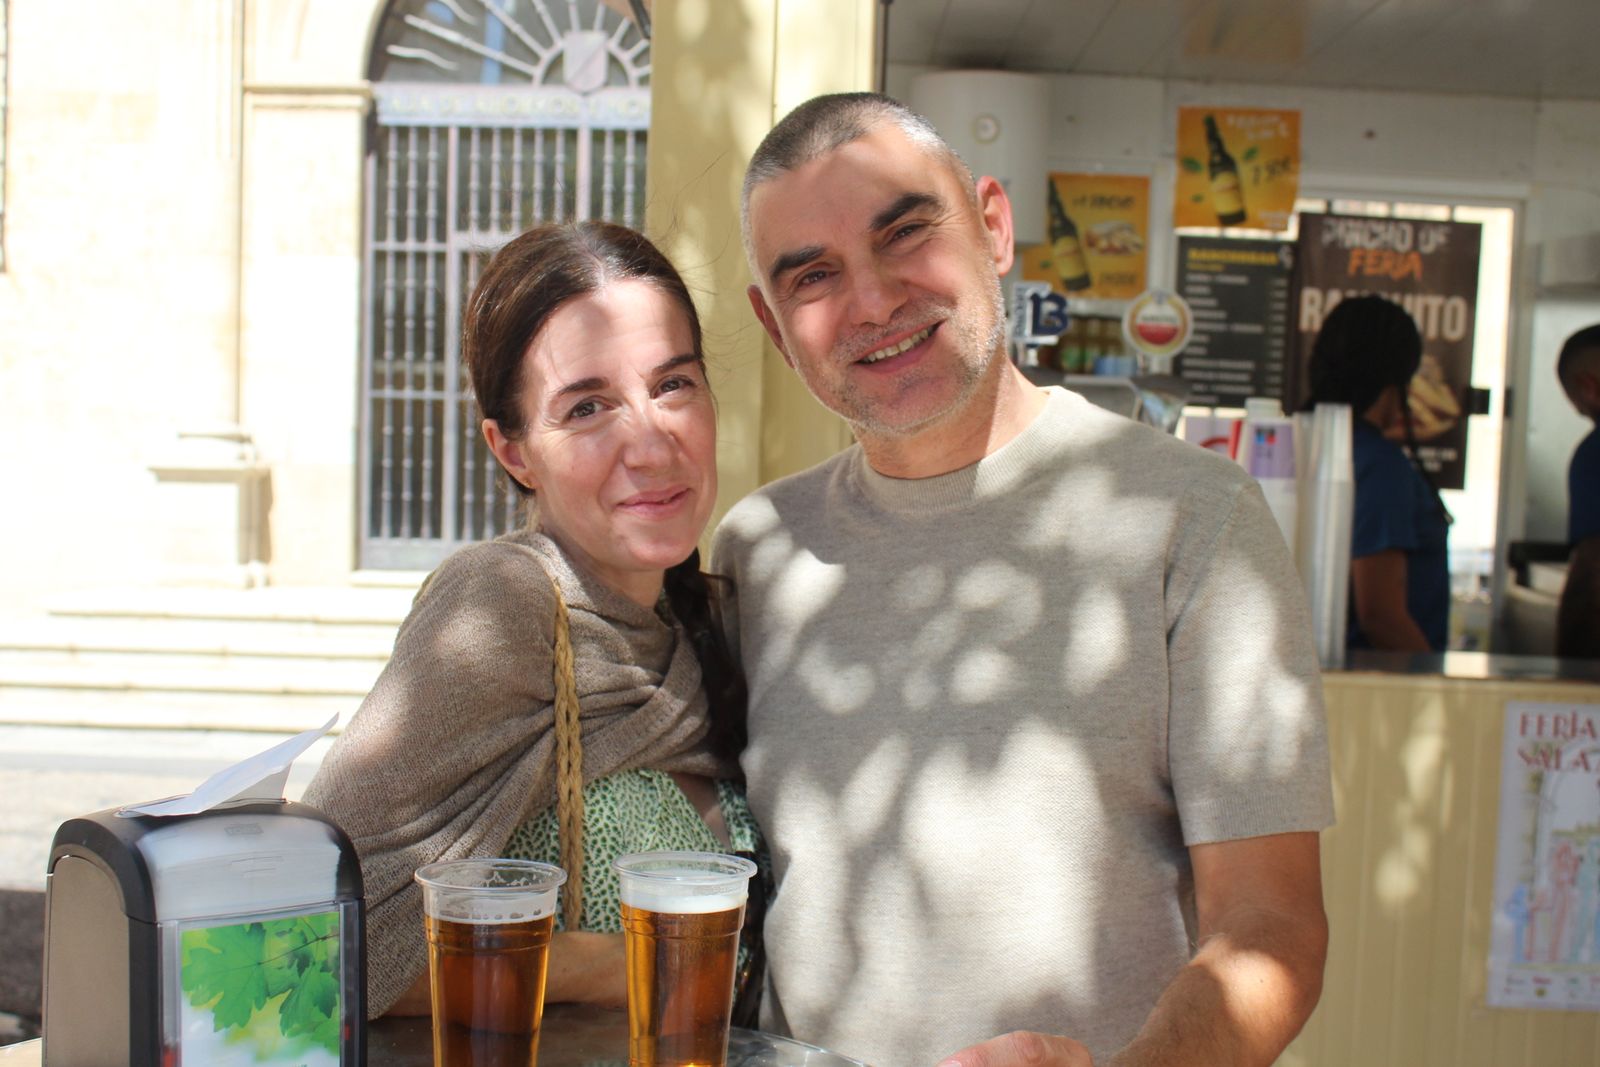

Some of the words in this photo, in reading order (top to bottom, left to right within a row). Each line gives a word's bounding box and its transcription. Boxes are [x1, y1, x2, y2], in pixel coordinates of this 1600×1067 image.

[1347, 249, 1422, 281] FERIA
[1519, 706, 1597, 740] FERIA
[1517, 745, 1600, 774] SALA
